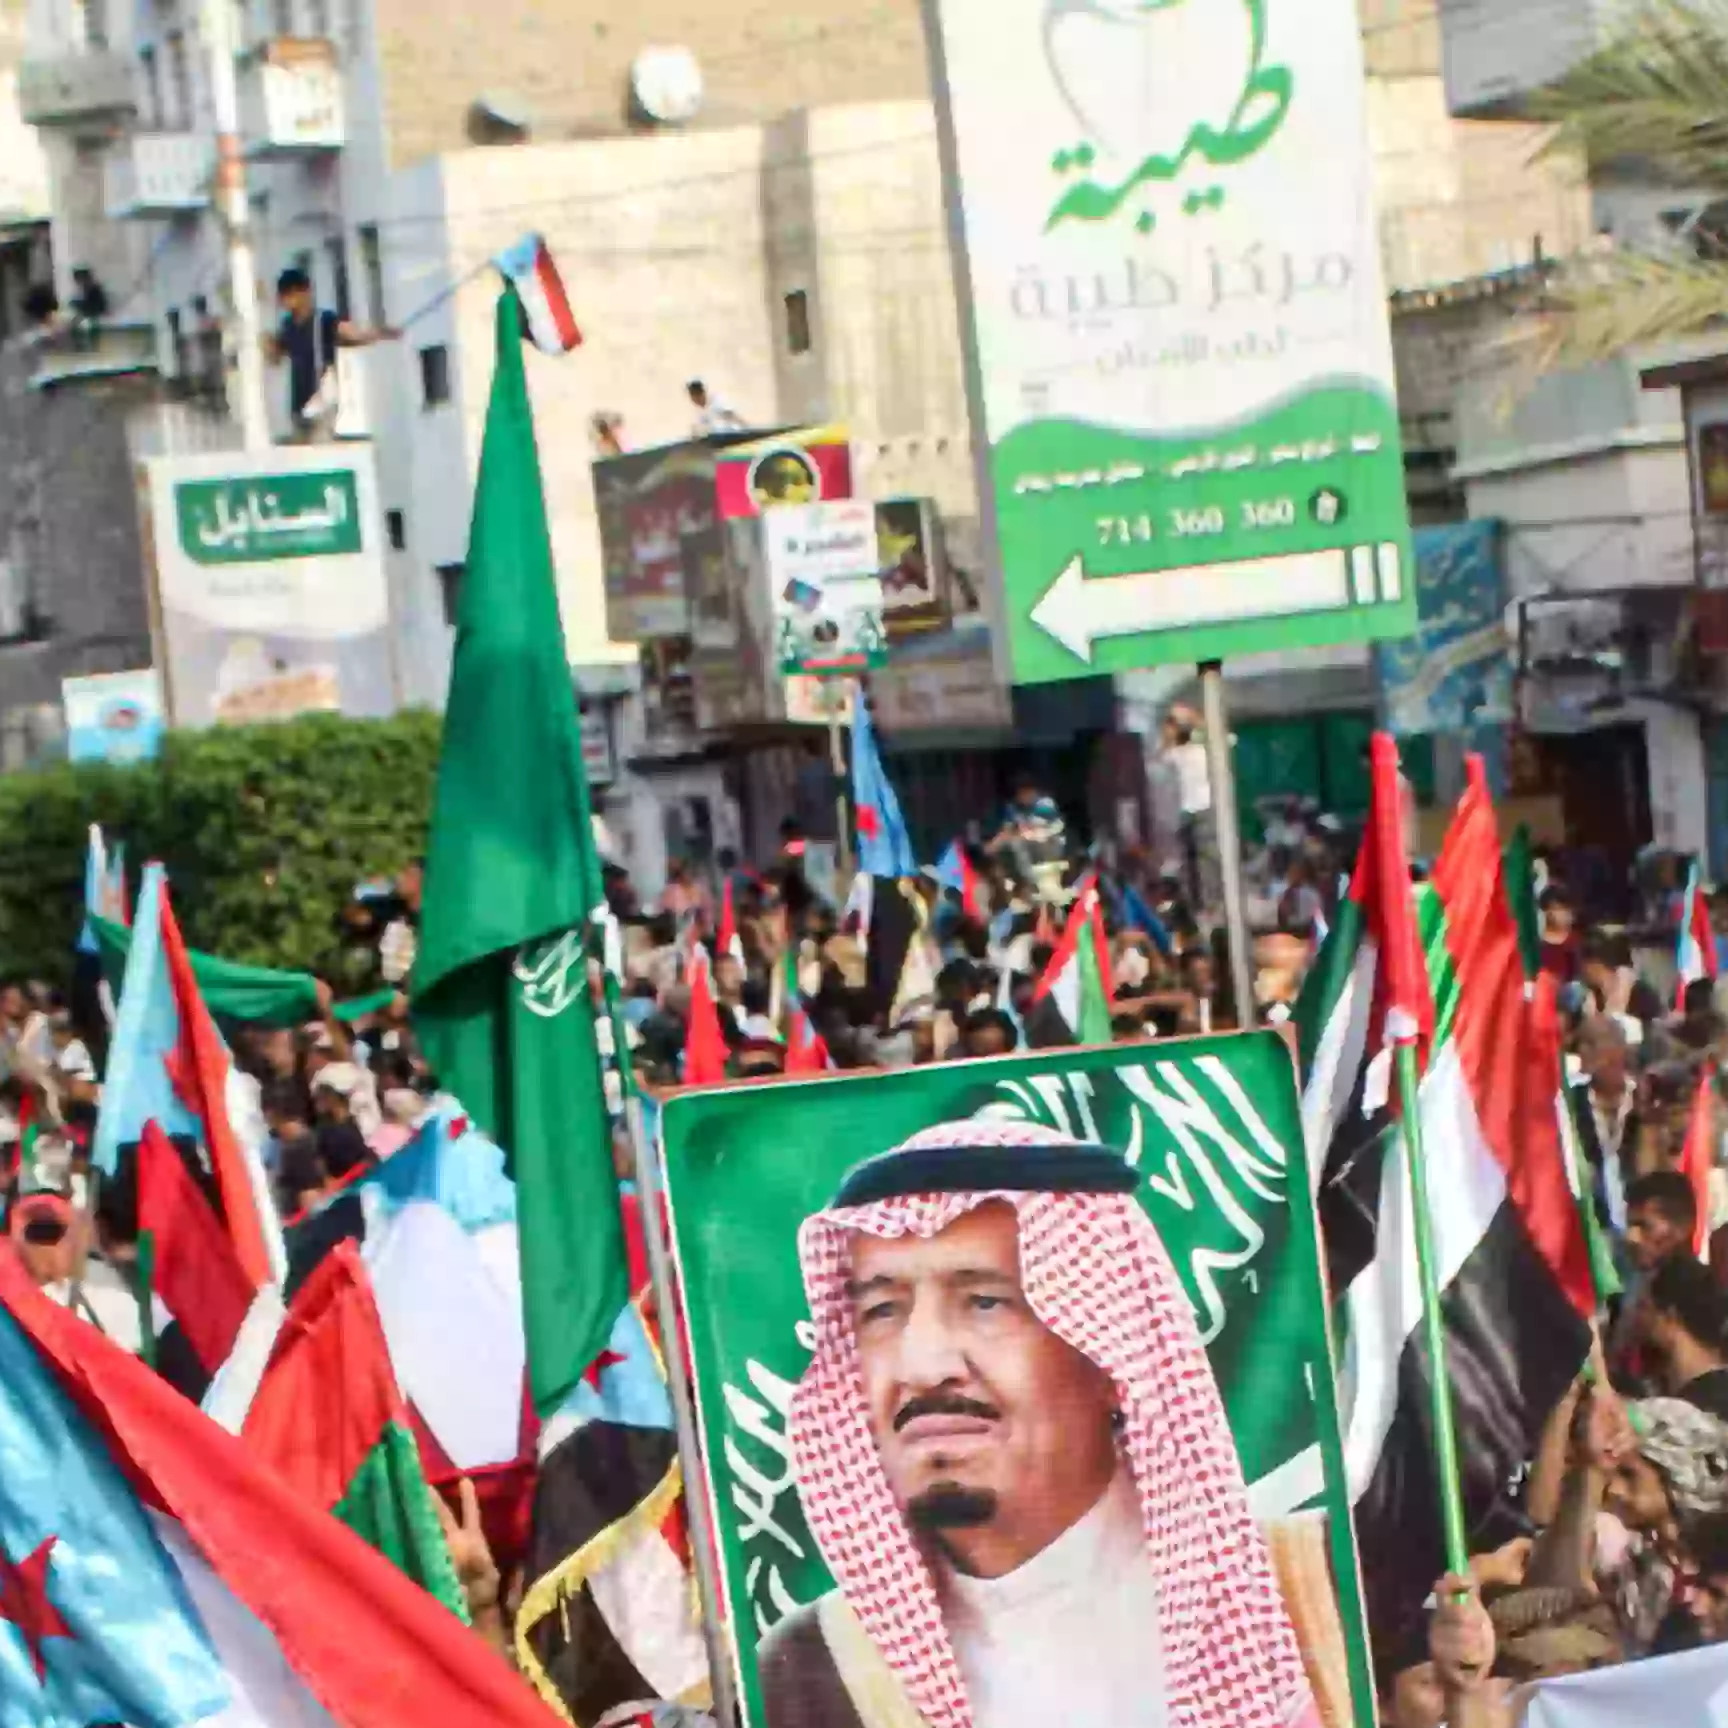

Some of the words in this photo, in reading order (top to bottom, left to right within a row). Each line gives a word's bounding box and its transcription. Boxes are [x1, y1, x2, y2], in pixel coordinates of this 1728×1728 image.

[1009, 257, 1179, 329] طيبة
[1207, 241, 1353, 313] مركز
[198, 485, 347, 550] السنابل
[1095, 514, 1153, 545] 714
[1169, 505, 1224, 539] 360
